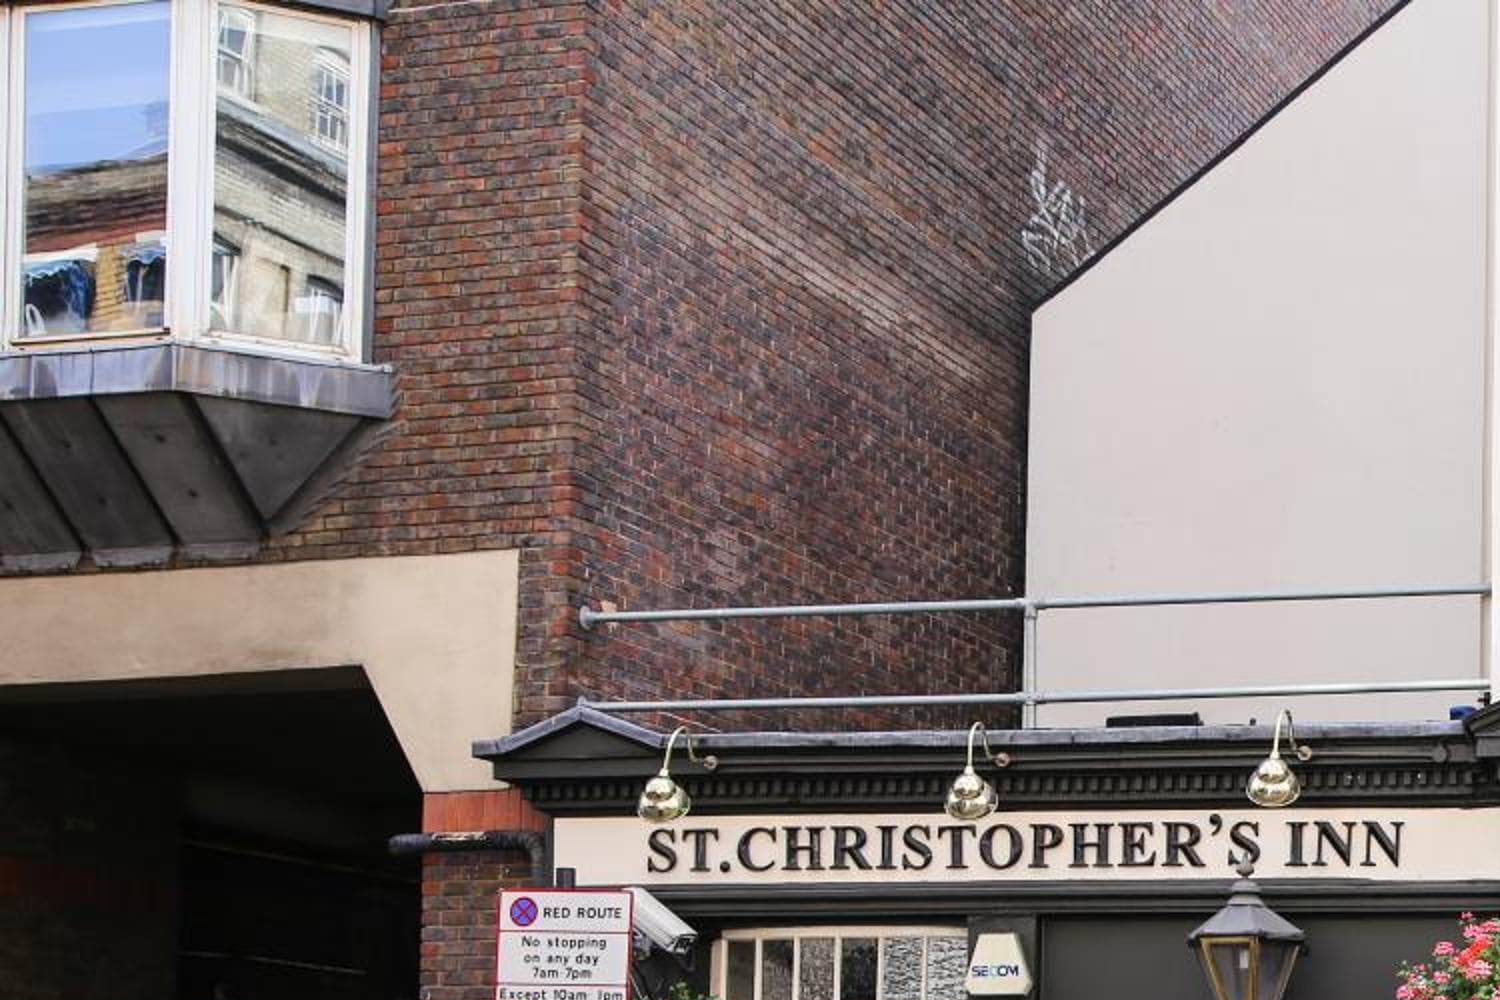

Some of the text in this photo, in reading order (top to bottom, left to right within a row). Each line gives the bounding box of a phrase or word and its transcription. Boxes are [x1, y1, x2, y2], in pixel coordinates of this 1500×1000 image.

[1285, 821, 1404, 867] INN
[543, 907, 622, 919] RED ROUTE
[521, 935, 607, 950] No stopping
[523, 950, 600, 966] on any day
[533, 967, 592, 979] 7am 7pm
[972, 965, 1019, 976] SECOM
[500, 988, 547, 1000] Except
